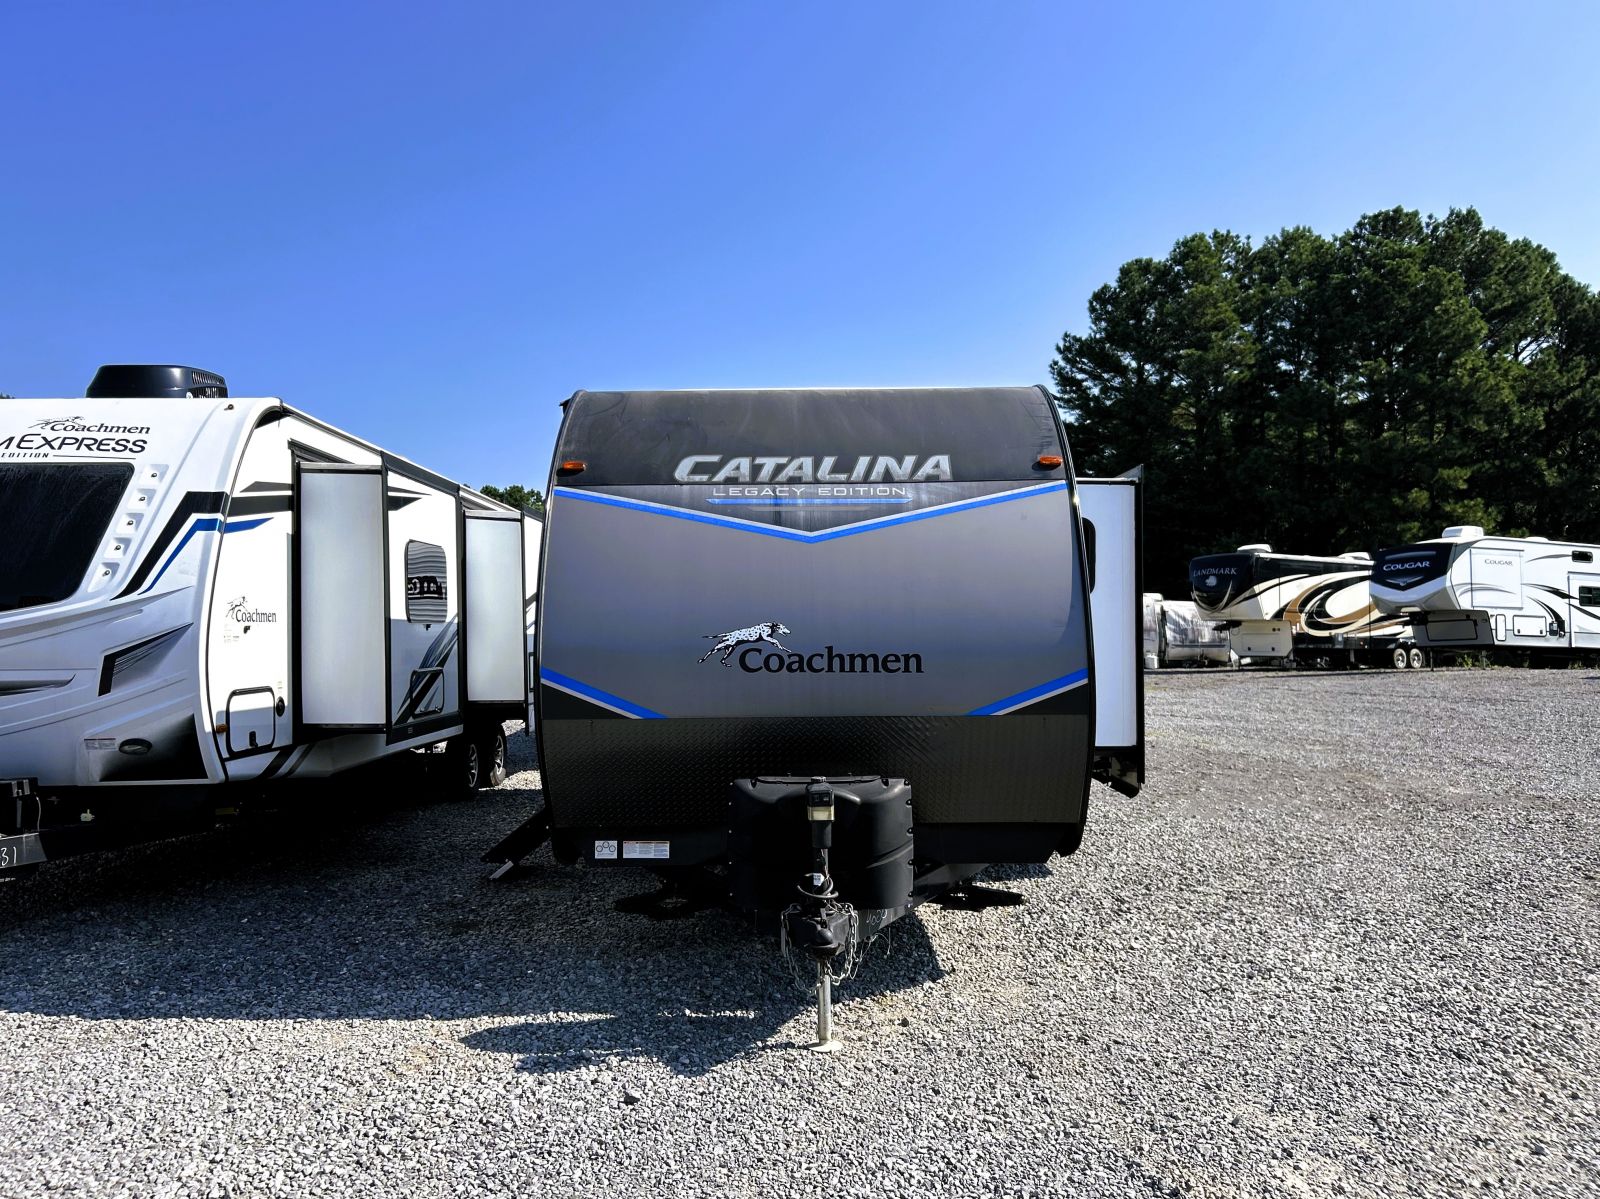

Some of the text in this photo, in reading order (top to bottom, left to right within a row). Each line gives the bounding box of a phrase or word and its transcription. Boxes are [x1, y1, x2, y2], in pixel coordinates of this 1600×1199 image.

[50, 423, 150, 434] Coachmen
[16, 433, 147, 453] EXPRESS
[673, 454, 953, 483] CATALINA
[713, 487, 906, 496] LEGACY EDITION
[1382, 560, 1431, 572] COUGAR
[1484, 558, 1514, 566] COUGAR
[1193, 567, 1237, 577] LANDMARK
[235, 608, 277, 622] Coachmen
[738, 645, 924, 674] Coachmen
